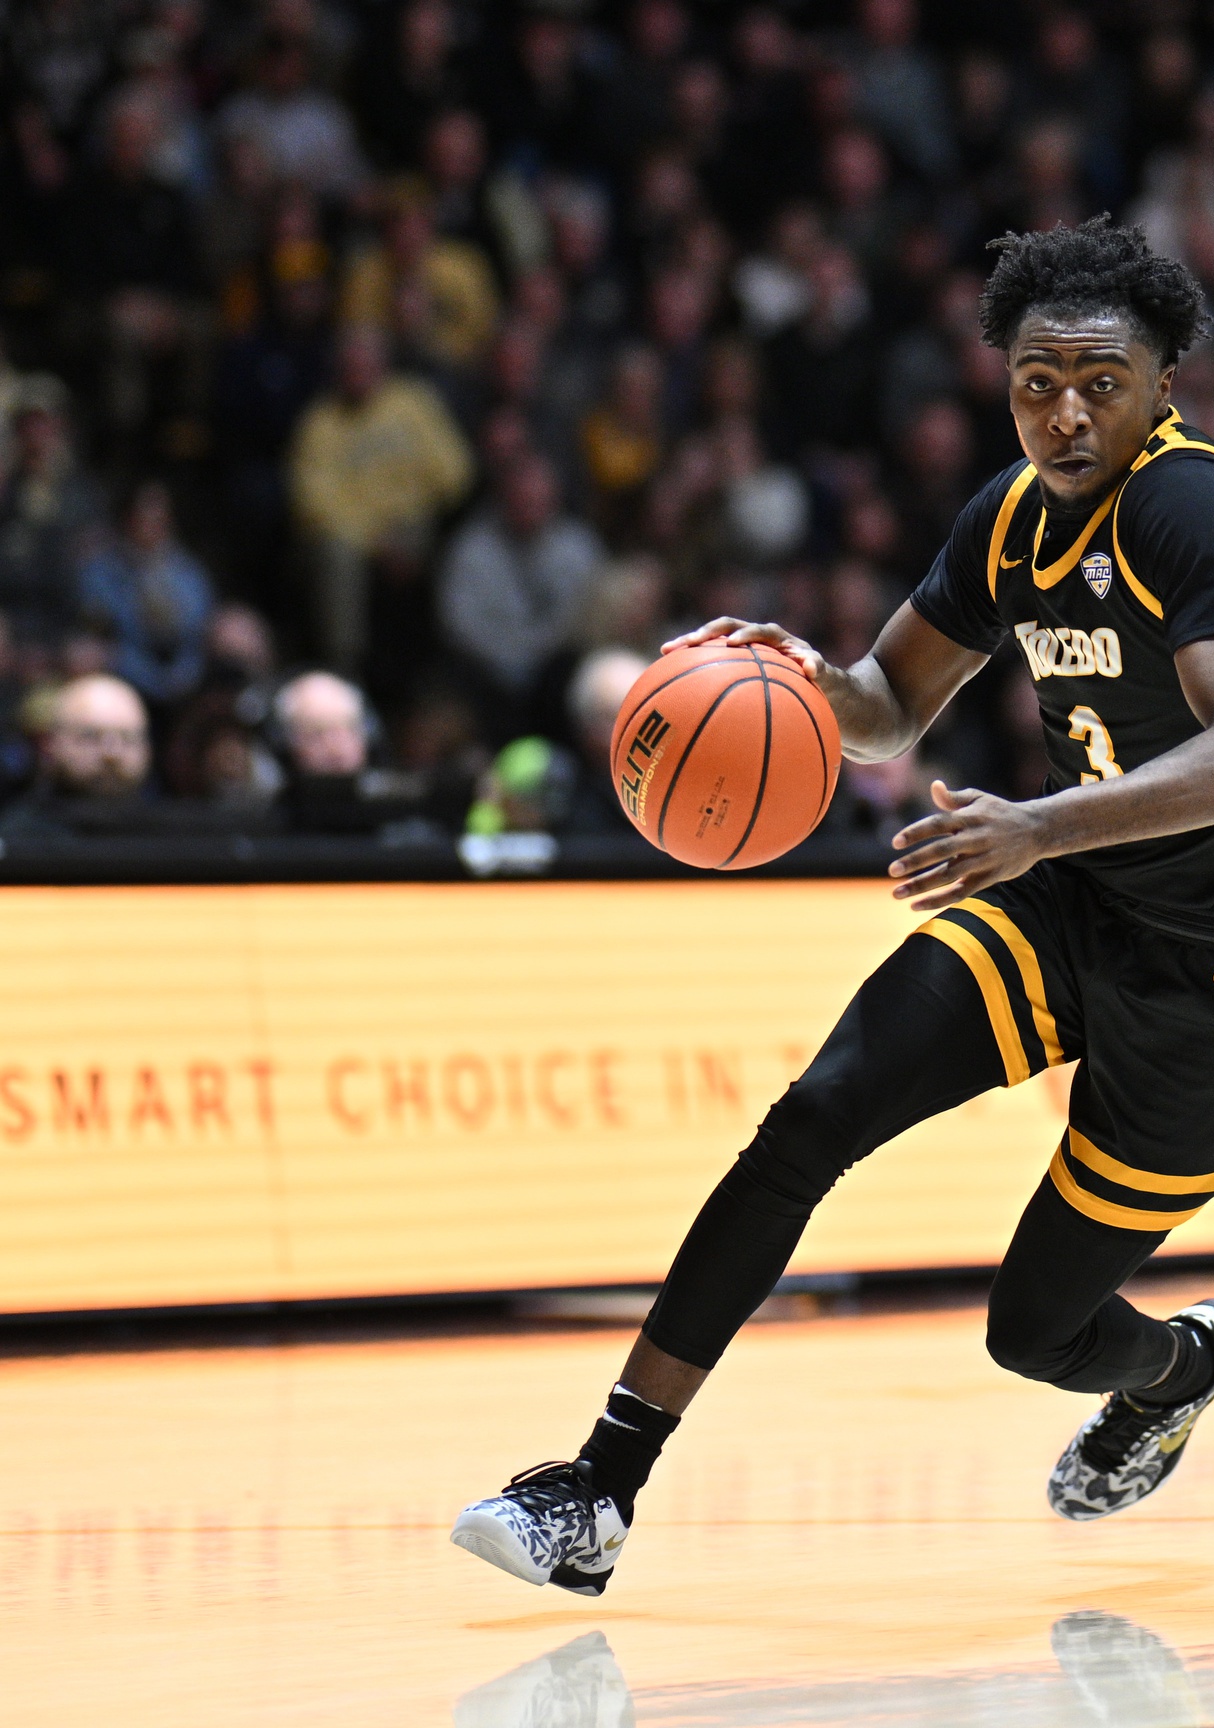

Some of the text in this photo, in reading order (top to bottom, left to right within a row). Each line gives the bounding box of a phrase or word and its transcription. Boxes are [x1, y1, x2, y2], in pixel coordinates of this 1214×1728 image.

[1084, 567, 1111, 580] MAC
[1014, 619, 1124, 682] TOLEDO
[1067, 704, 1126, 786] 3
[0, 1060, 278, 1145] SMART
[324, 1038, 630, 1137] CHOICE
[662, 1047, 748, 1130] IN
